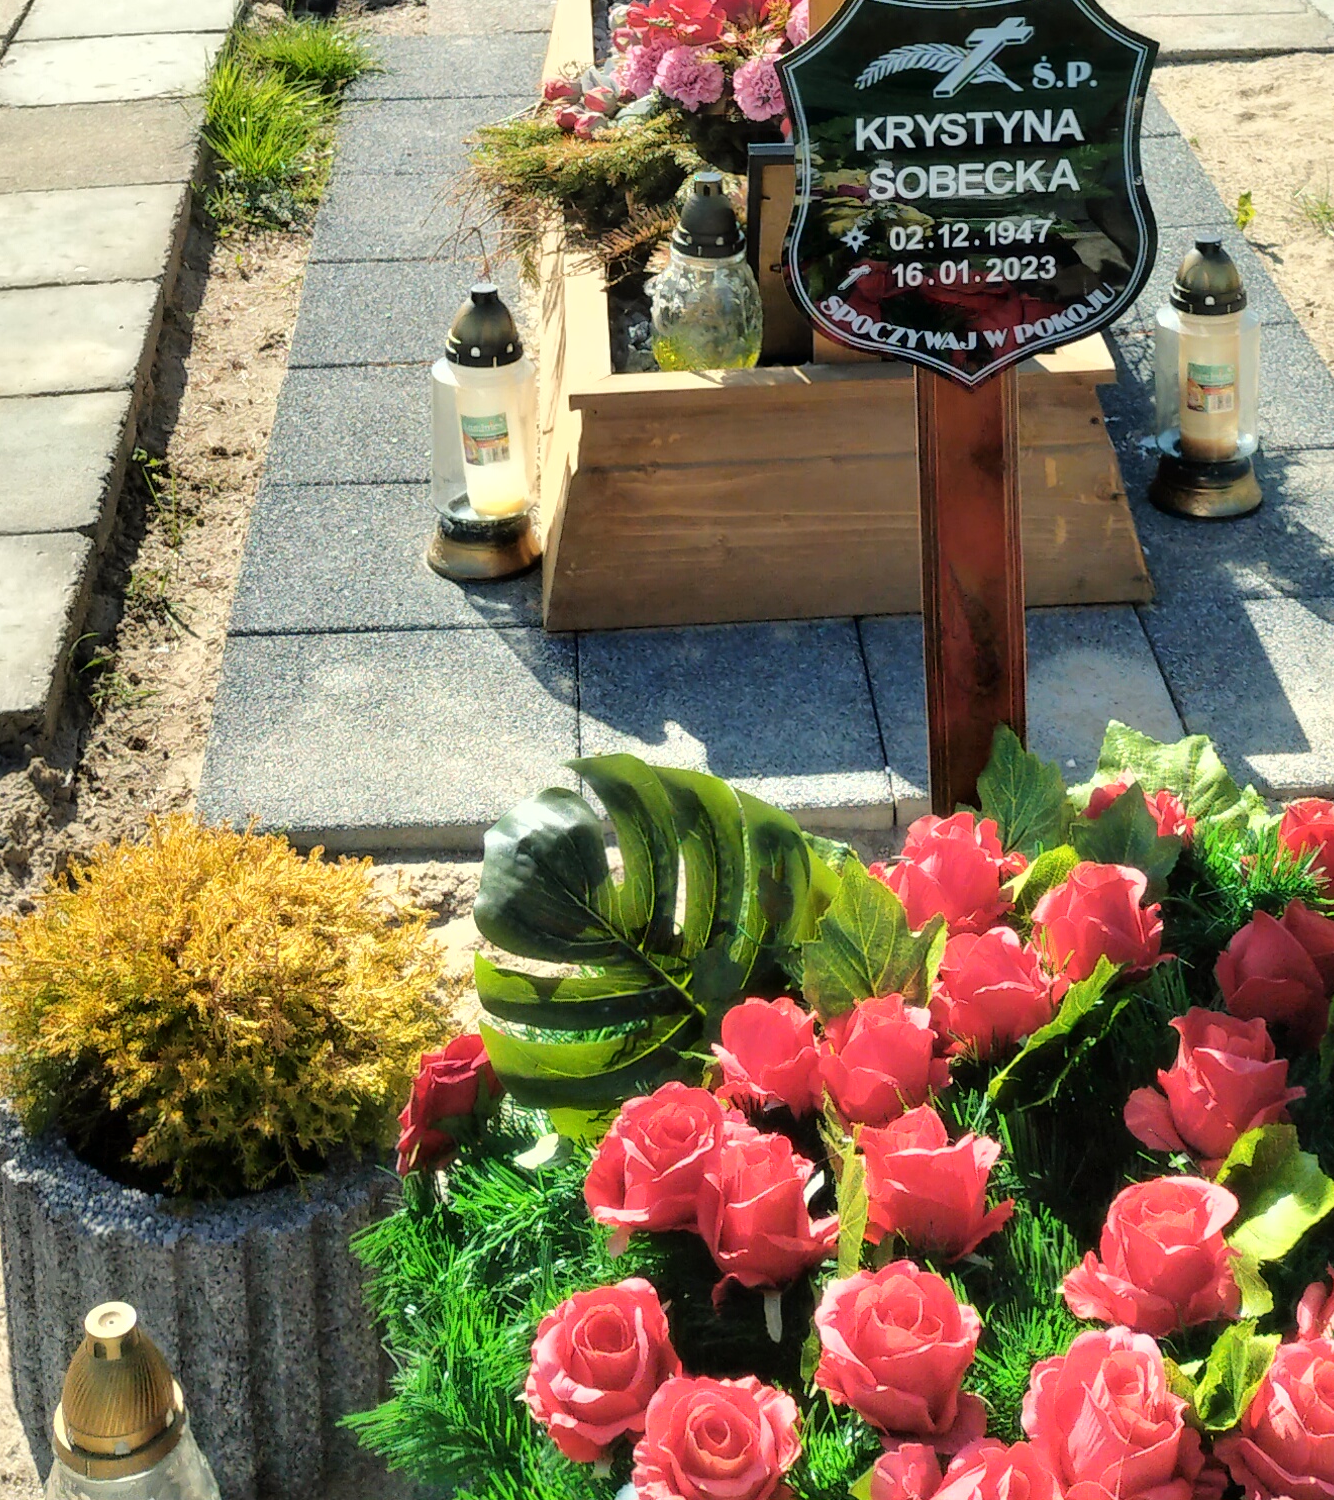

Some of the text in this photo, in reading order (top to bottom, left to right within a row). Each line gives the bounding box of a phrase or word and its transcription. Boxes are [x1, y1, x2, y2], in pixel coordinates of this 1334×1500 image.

[1032, 55, 1099, 90] Ś.P.
[854, 108, 1085, 152] KRYSTYNA
[868, 158, 1081, 201] SOBECKA
[889, 218, 1054, 252] 02.12.1947
[891, 255, 1058, 289] 16.01.2023
[820, 283, 1116, 350] SPOCZYWAJ W POKOJU
